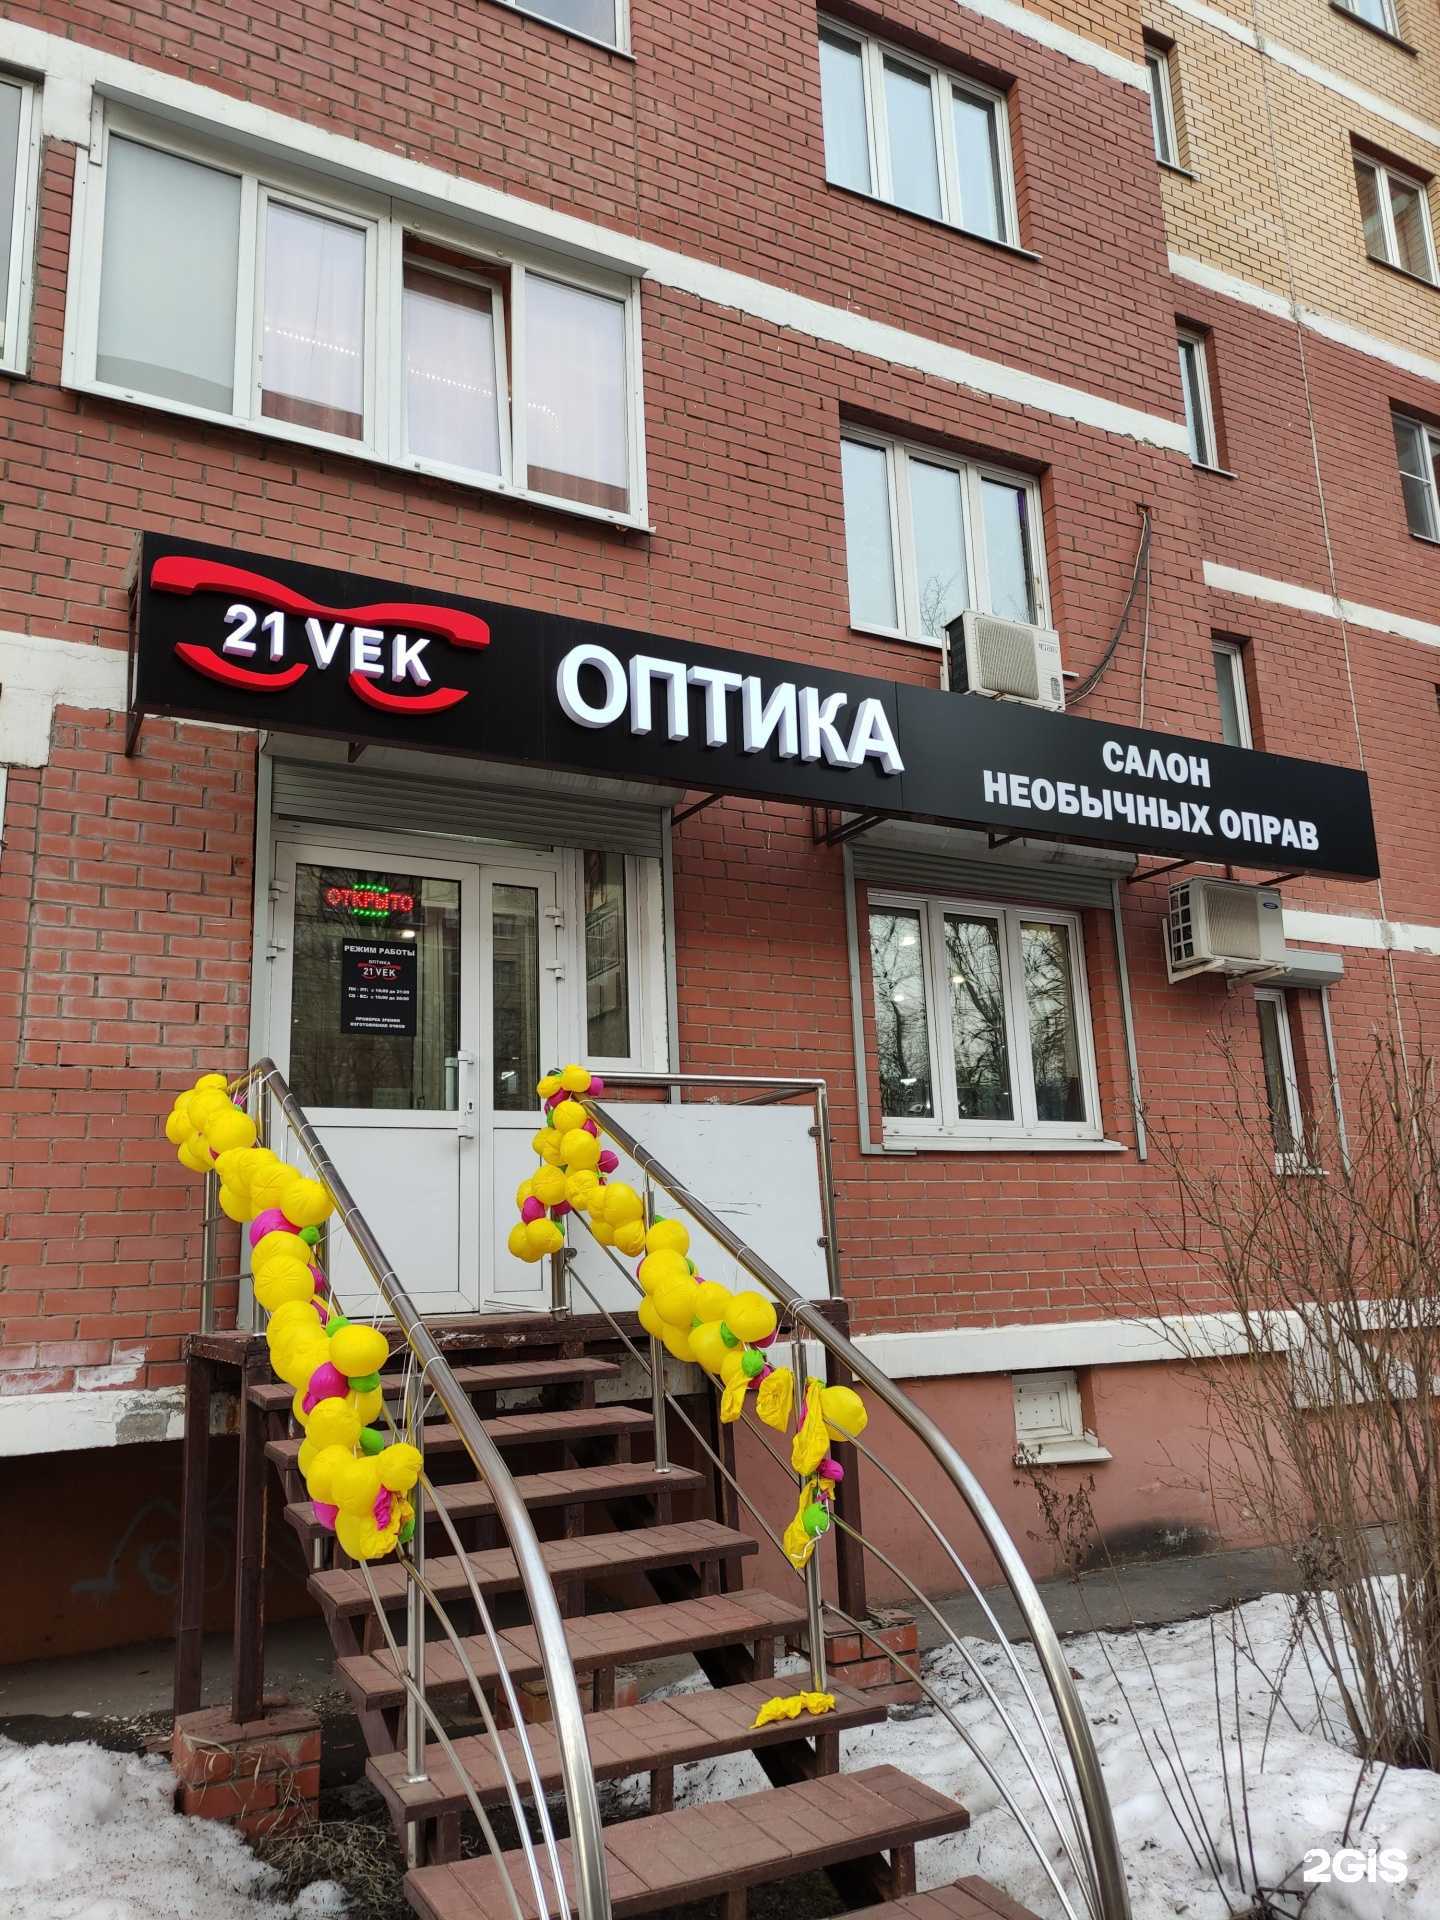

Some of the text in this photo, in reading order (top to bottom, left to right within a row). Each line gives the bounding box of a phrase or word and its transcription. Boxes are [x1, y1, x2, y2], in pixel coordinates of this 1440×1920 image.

[223, 604, 431, 686] 21 VEK
[556, 644, 905, 775] ОПТИКА
[1102, 741, 1211, 788] САЛОН
[983, 769, 1319, 851] НЕОБЫЧНЫХ ОПРАВ
[326, 888, 414, 912] ОТКРЫТО
[344, 945, 415, 956] РЕЖИМ РАБОТЫ
[363, 967, 396, 977] 21 VEK
